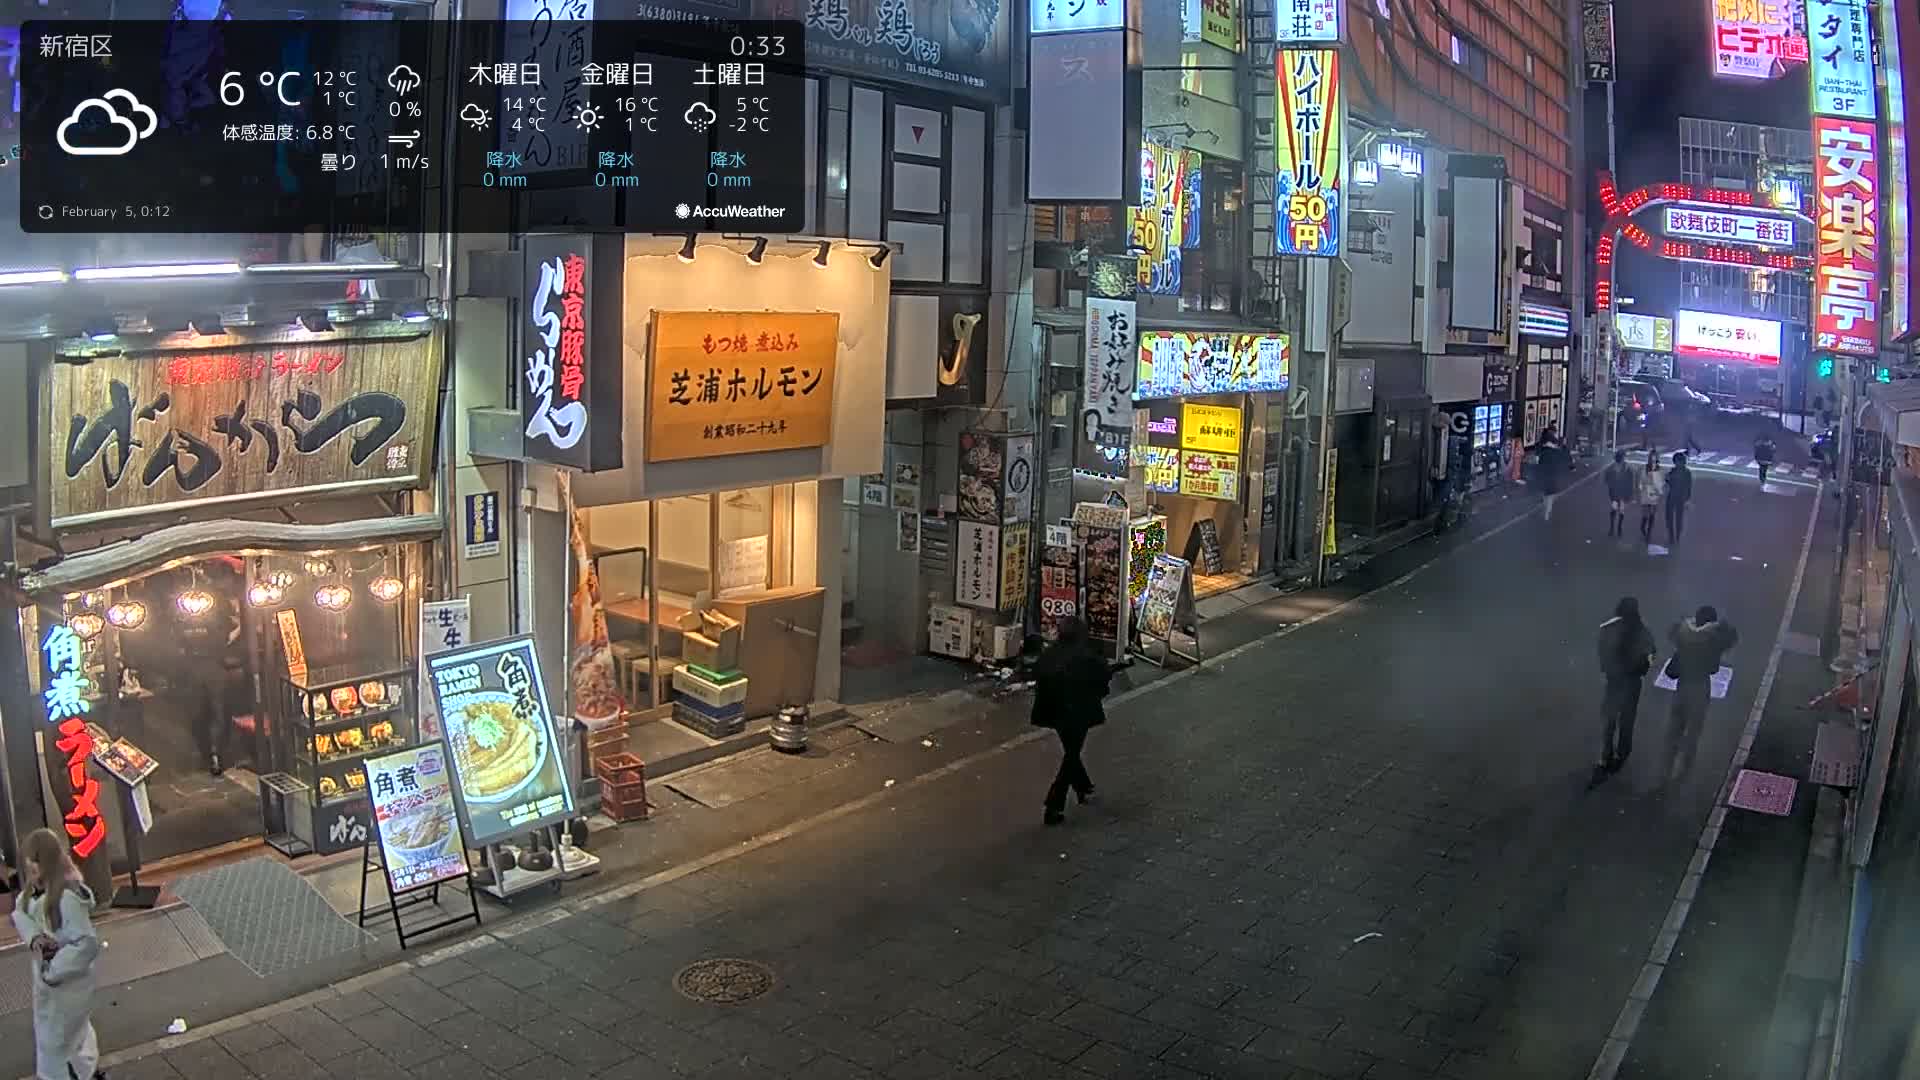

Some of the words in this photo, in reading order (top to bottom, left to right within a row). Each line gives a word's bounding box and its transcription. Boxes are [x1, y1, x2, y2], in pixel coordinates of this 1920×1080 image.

[1589, 64, 1610, 78] 7F
[1833, 97, 1856, 111] 3F
[1294, 51, 1323, 191] ハイボール
[1671, 211, 1790, 242] 歌舞伎町一番街
[1819, 127, 1876, 331] 安楽亭
[560, 253, 585, 400] 東京豚骨
[1818, 332, 1837, 347] 2F
[702, 333, 749, 354] もつ焼
[755, 331, 800, 352] 煮込み
[669, 366, 823, 406] 芝浦ホルモン
[65, 377, 408, 493] ばんから
[702, 419, 788, 440] 創業昭和二十九年
[1048, 530, 1068, 546] 4階
[972, 526, 983, 601] 芝浦ホルモン
[435, 663, 480, 683] TOKYO
[438, 676, 482, 697] RAMEN
[499, 653, 538, 720] 角煮
[374, 765, 419, 798] 角煮
